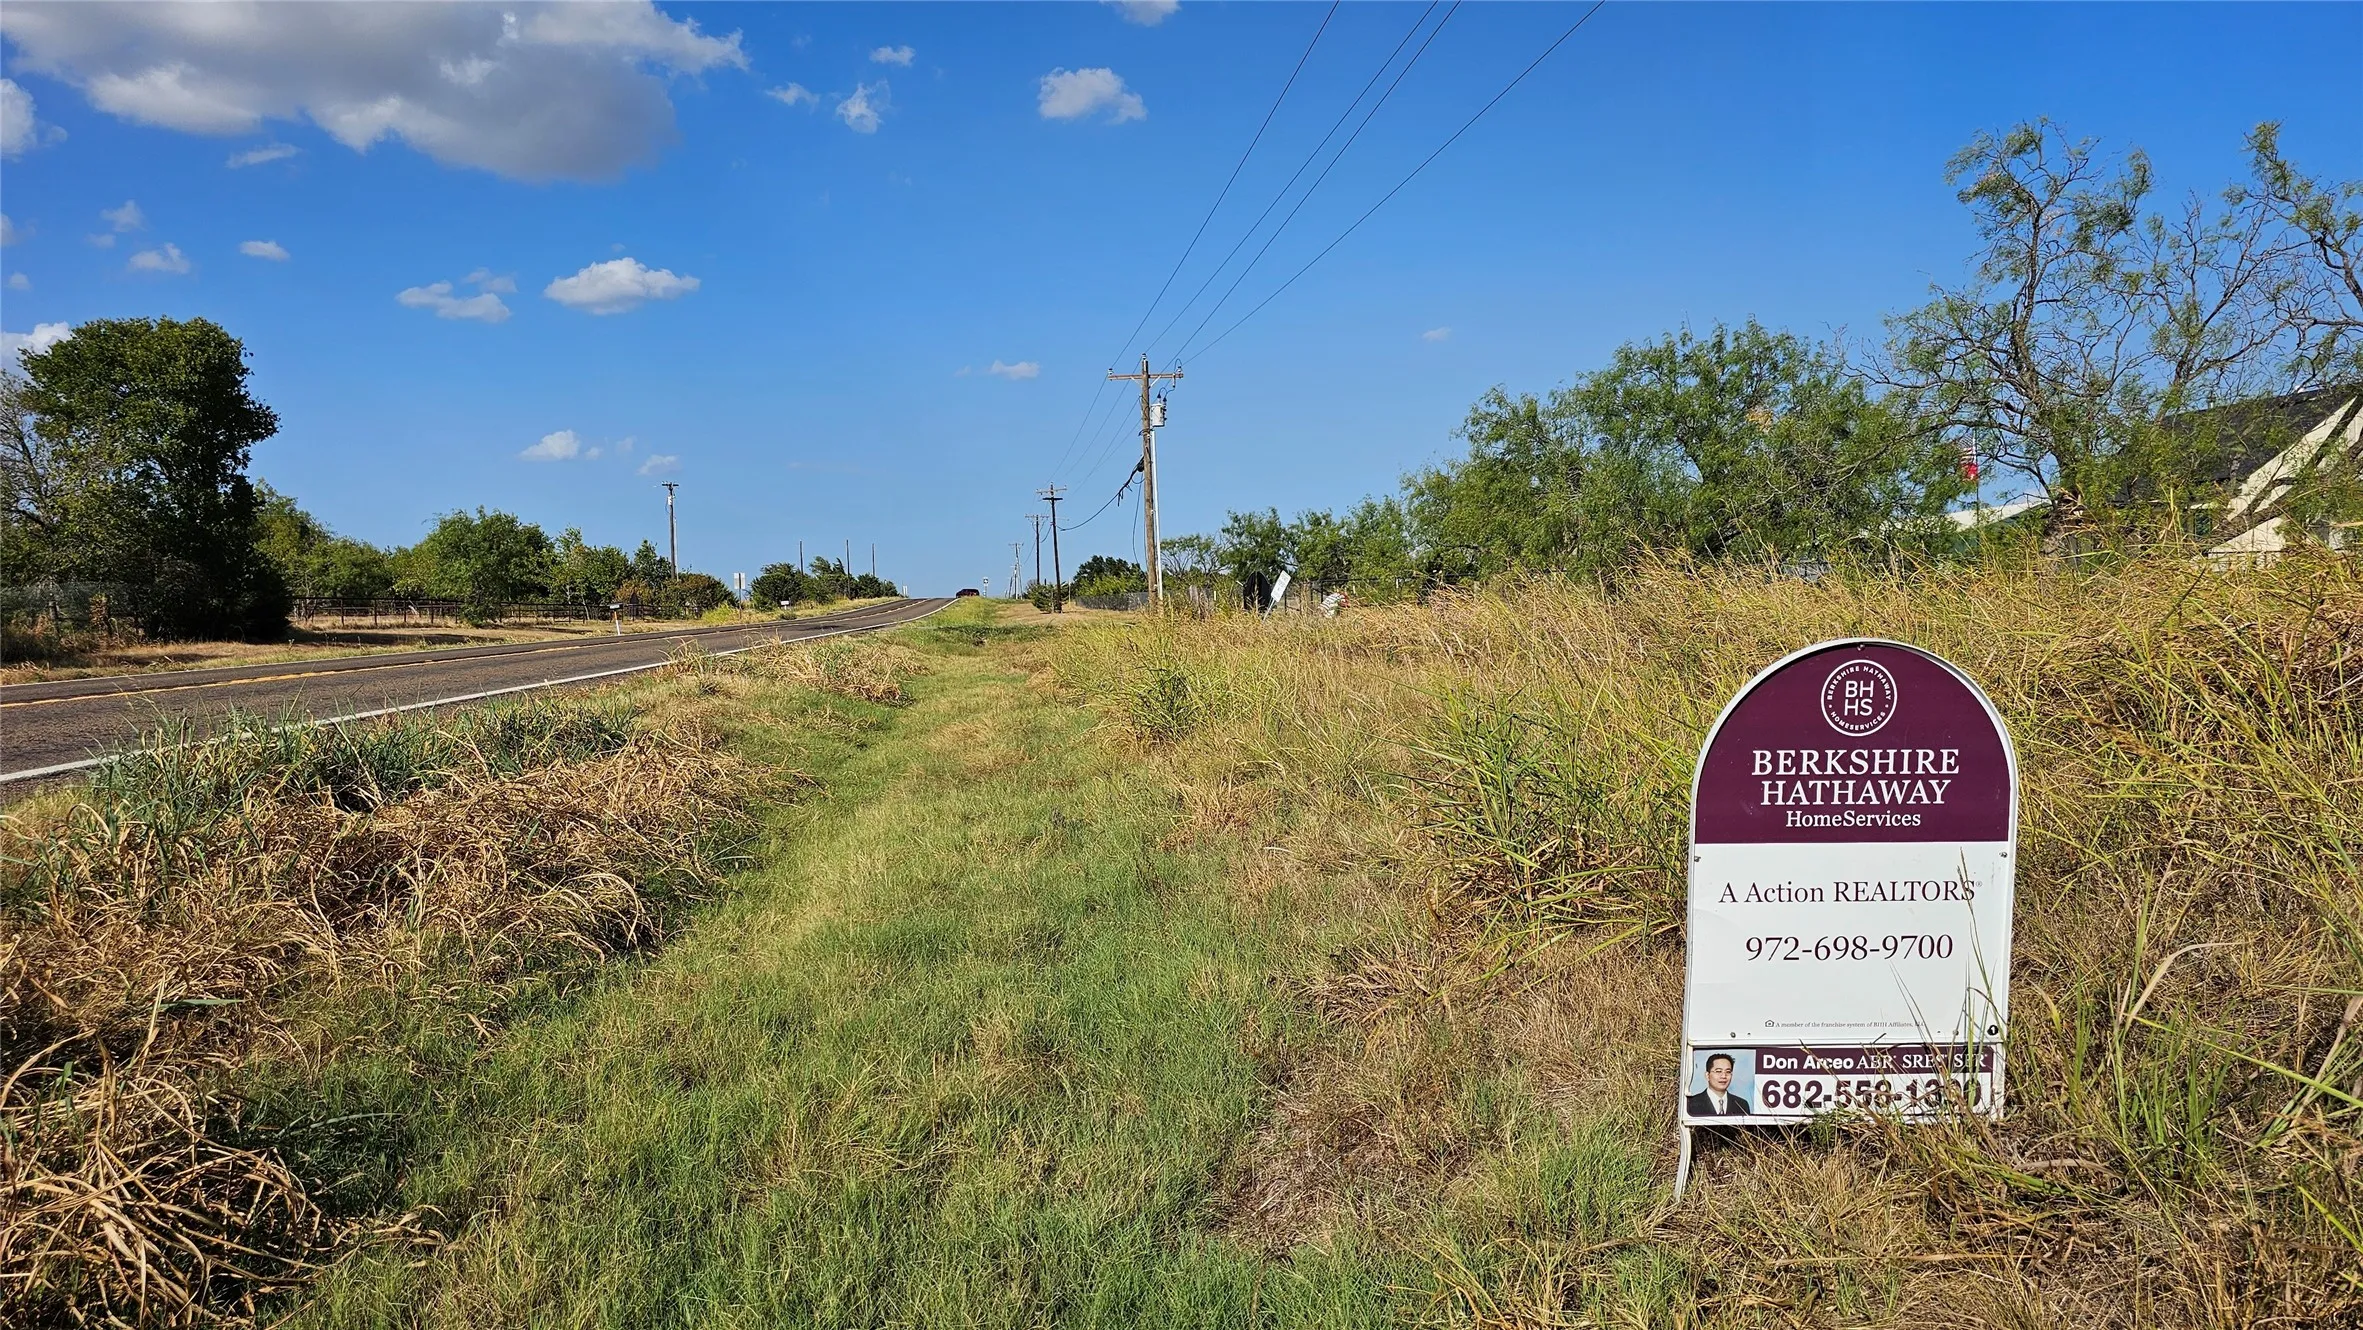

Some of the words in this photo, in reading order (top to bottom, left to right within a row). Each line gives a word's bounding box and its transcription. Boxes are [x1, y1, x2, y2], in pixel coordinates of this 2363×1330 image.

[1827, 666, 1859, 700] BERKSHIRE
[1863, 666, 1891, 700] HATHAWAY
[1845, 680, 1874, 698] BH
[1844, 698, 1873, 716] HS
[1830, 711, 1886, 731] HOMESERVICES
[1751, 748, 1960, 776] BERKSHIRE
[1760, 779, 1951, 805] HATHAWAY
[1786, 810, 1921, 827] HomeServices
[1718, 881, 1739, 903] A
[1744, 881, 1825, 903] Action
[1745, 934, 1953, 962] 972-698-9700
[1763, 1054, 1798, 1069] Don
[1803, 1054, 1854, 1069] Arceo
